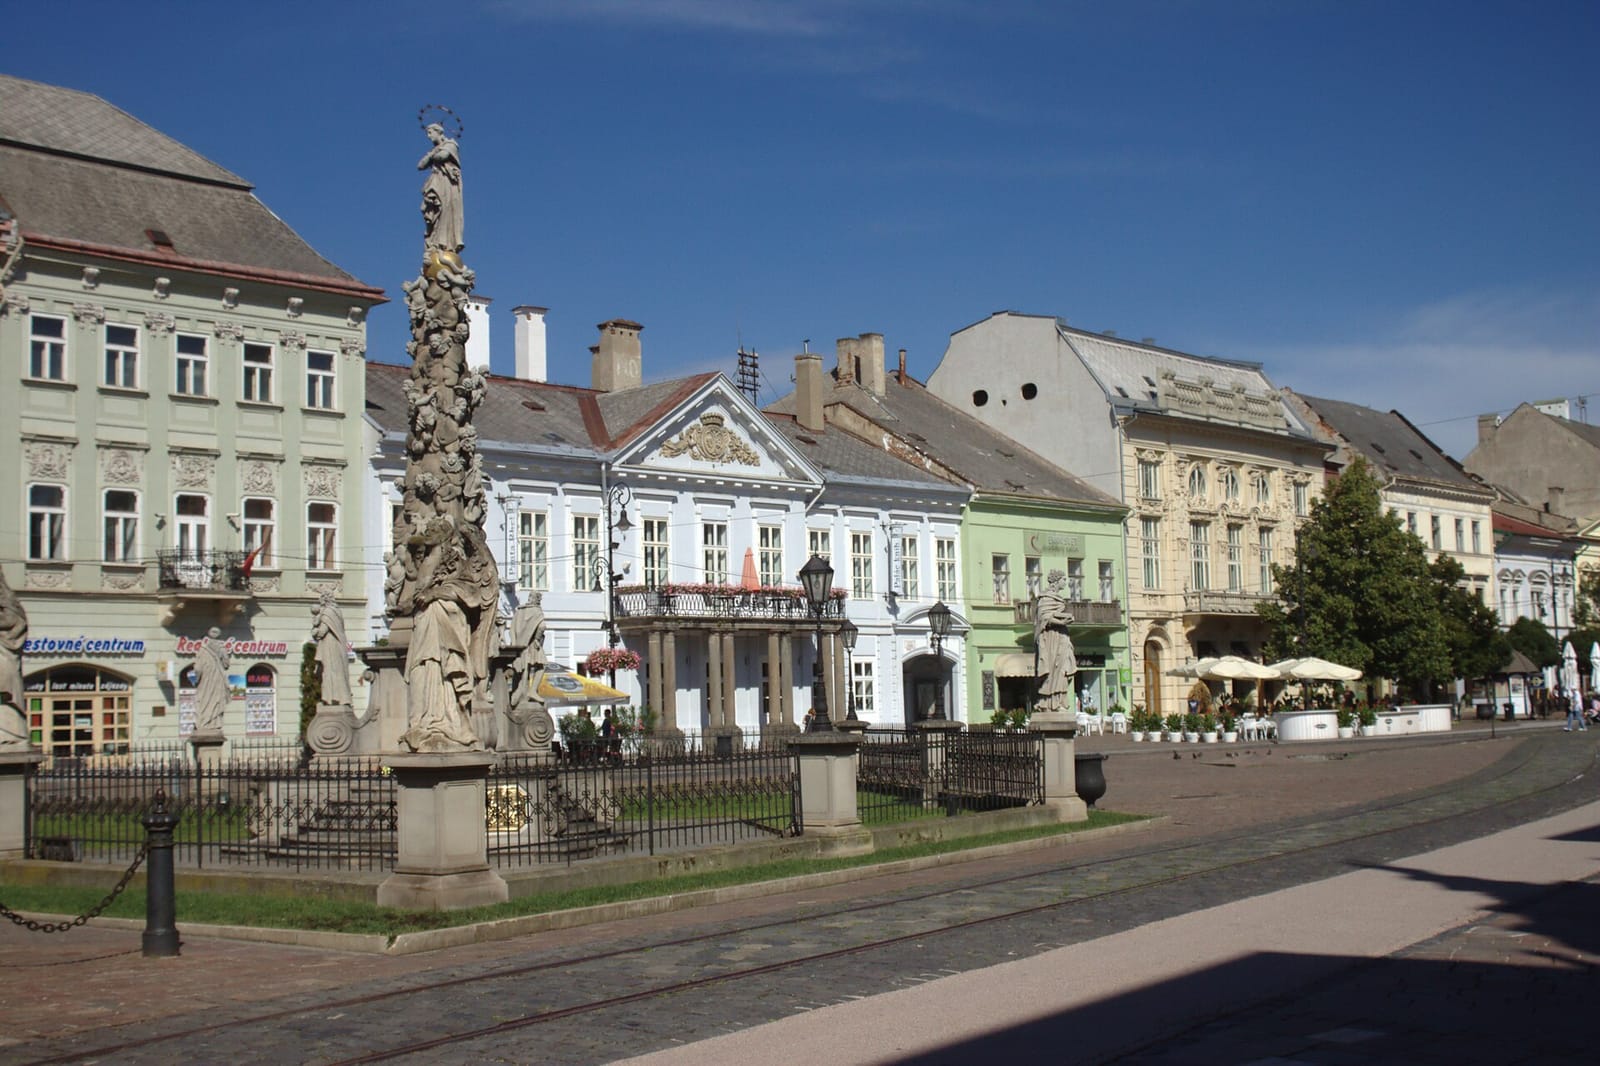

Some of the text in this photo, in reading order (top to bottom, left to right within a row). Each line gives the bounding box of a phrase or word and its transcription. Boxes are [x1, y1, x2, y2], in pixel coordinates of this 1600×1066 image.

[23, 635, 145, 652] estovné centrum
[233, 639, 288, 654] centrum
